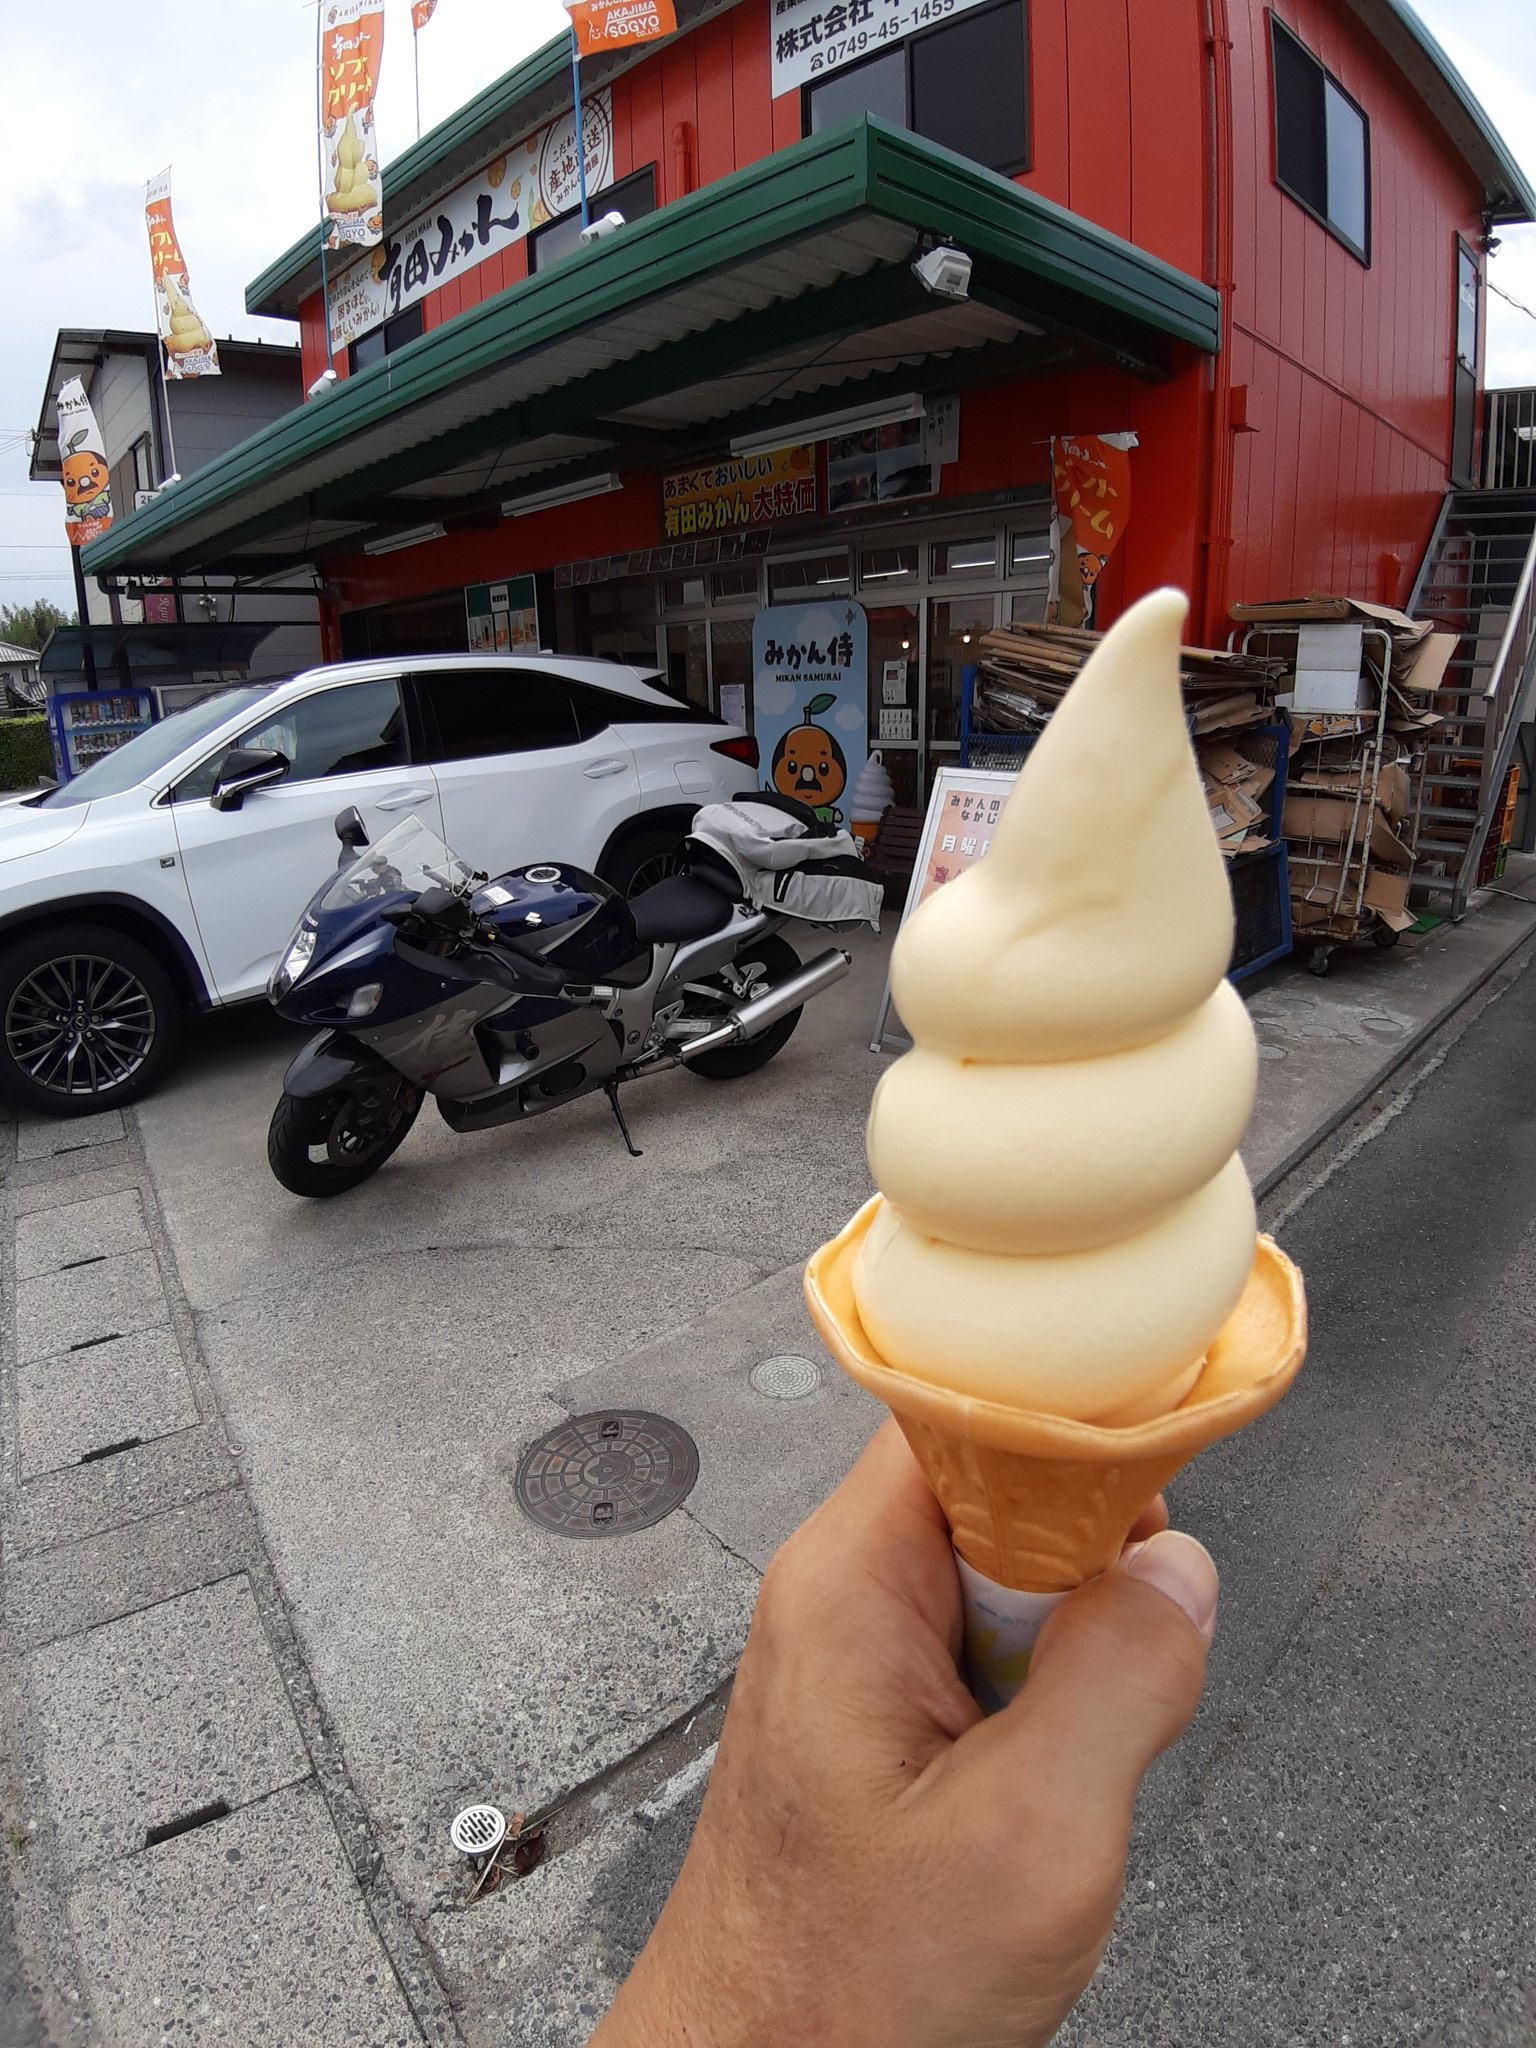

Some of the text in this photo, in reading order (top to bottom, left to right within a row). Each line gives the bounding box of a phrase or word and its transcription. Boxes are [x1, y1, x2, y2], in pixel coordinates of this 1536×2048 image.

[607, 0, 657, 23] AKAJIMA
[775, 0, 875, 64] 株式会社
[826, 0, 955, 65] 0749-45-1455
[663, 456, 774, 499] あまくておいしい
[664, 474, 817, 538] 有田みかん 大特価
[763, 631, 854, 671] みかん侍
[775, 672, 842, 683] MIKAN SAMURAI
